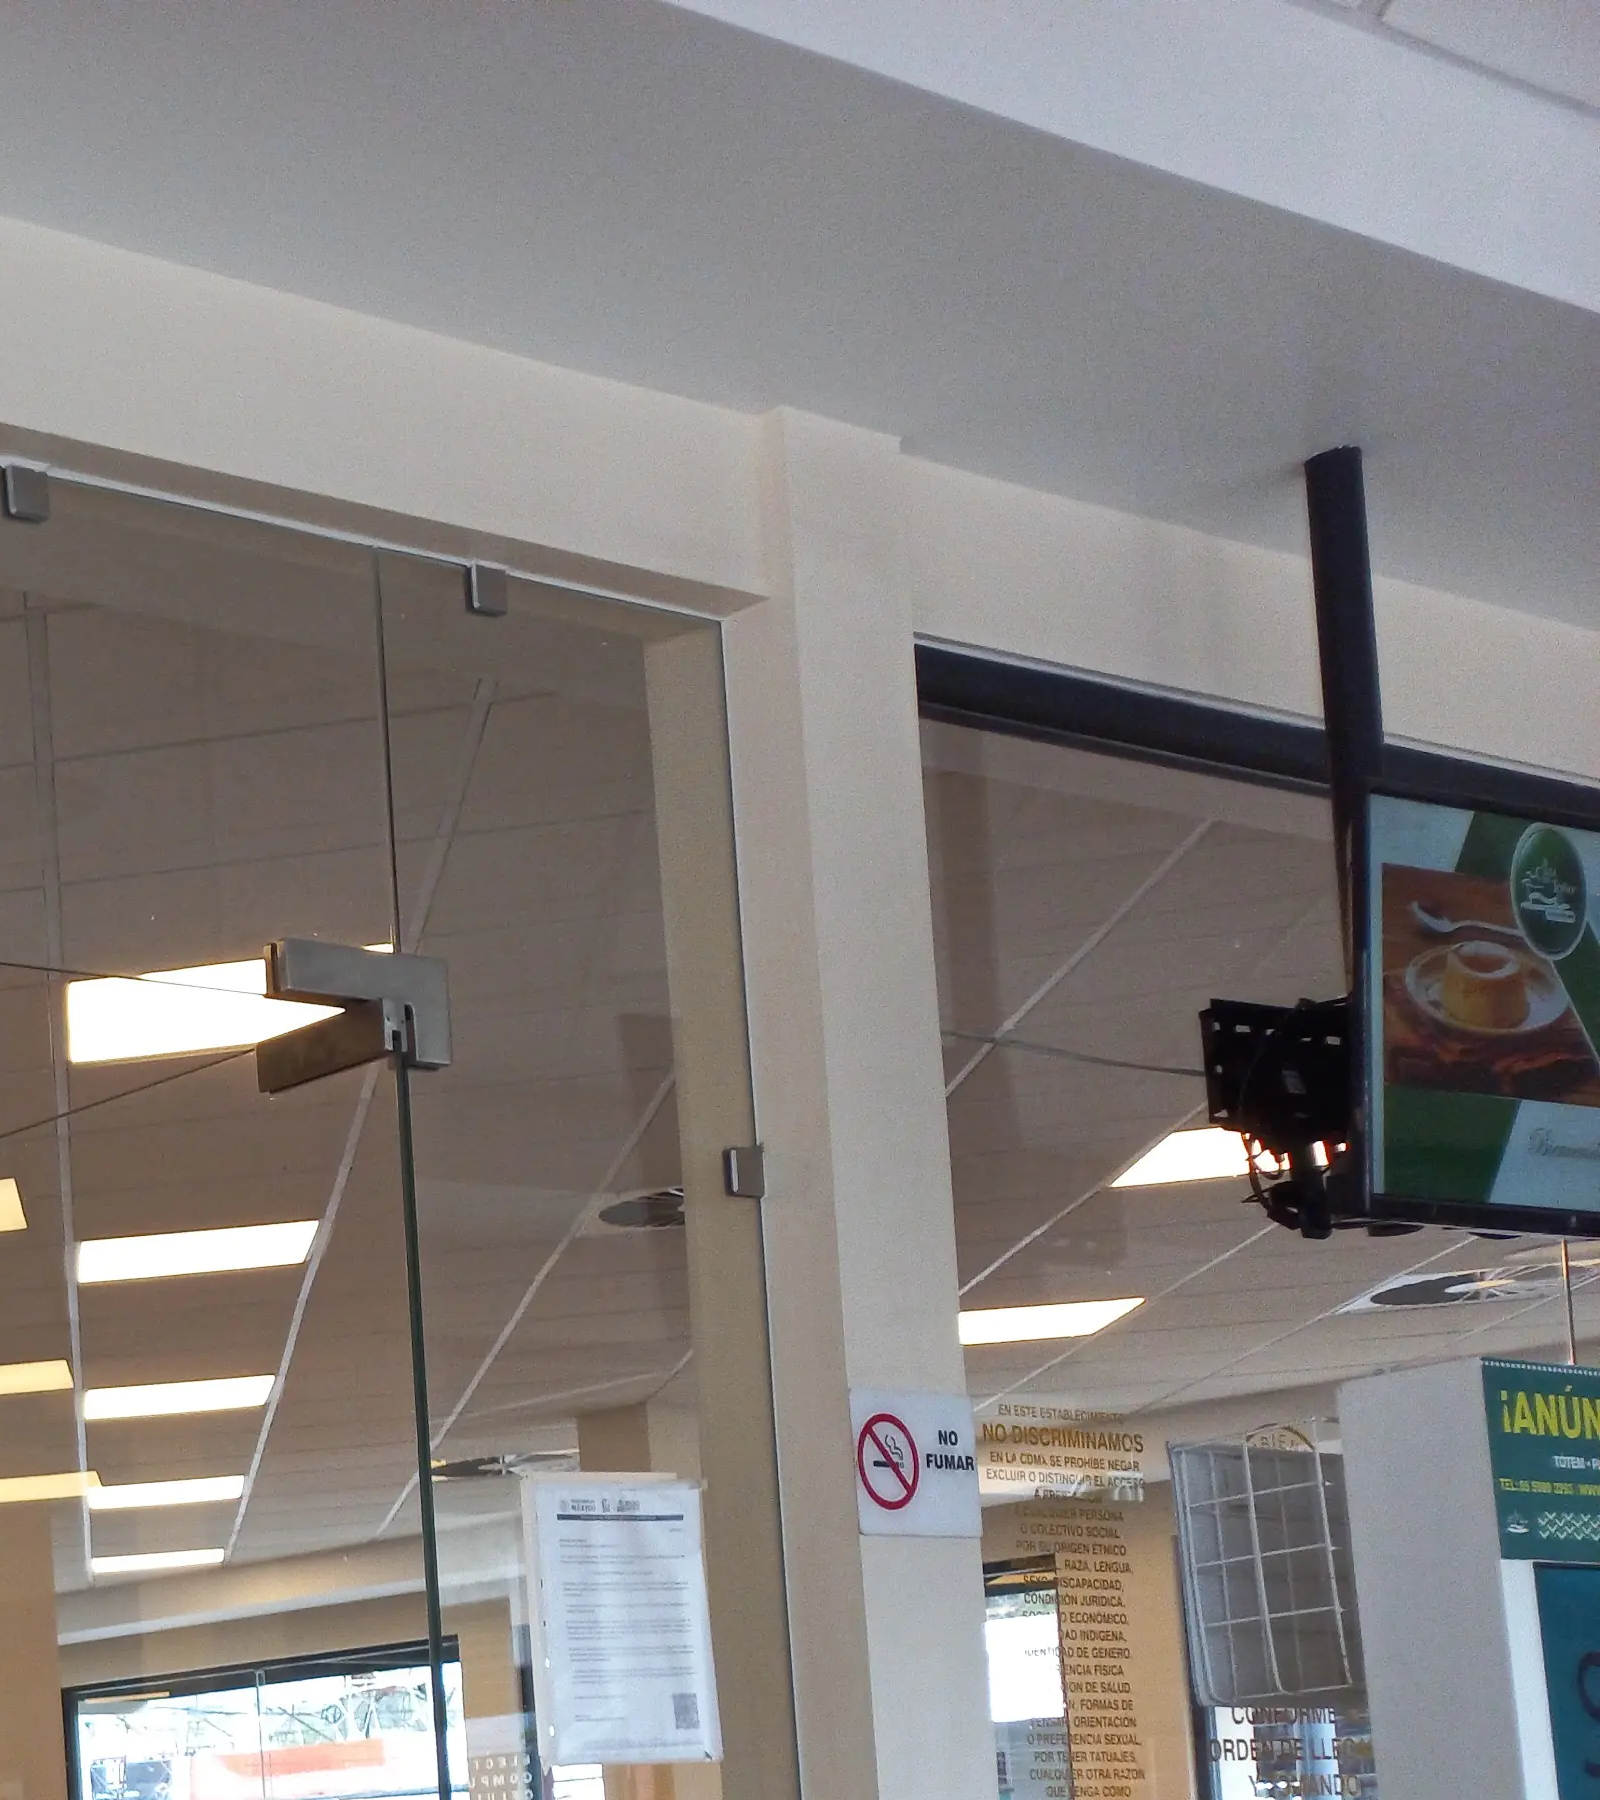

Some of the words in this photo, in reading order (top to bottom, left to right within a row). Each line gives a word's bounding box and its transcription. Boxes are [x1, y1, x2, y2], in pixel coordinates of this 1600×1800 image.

[998, 1404, 1011, 1416] EN
[1013, 1406, 1037, 1418] ESTE
[937, 1428, 959, 1448] NO
[982, 1423, 1007, 1442] NO
[1011, 1424, 1144, 1453] DISCRIMINAMOS
[925, 1451, 975, 1473] FUMAR
[990, 1451, 1003, 1463] EN
[1050, 1455, 1062, 1467] SE
[1108, 1460, 1140, 1472] NEGAR
[986, 1469, 1026, 1481] EXCLUIR
[1029, 1471, 1036, 1482] O
[1038, 1471, 1092, 1486] DISTINGUIR
[1094, 1476, 1105, 1487] EL
[1031, 1524, 1083, 1537] COLECTIVO
[1086, 1526, 1120, 1539] SOCIAL
[1016, 1540, 1036, 1551] POR
[1054, 1542, 1090, 1555] ORIGEN
[1077, 1648, 1089, 1658] DE
[1086, 1682, 1098, 1693] DE
[1080, 1699, 1119, 1711] FORMAS
[1122, 1699, 1133, 1711] DE
[1037, 1734, 1102, 1747] PREFERENCIA
[1033, 1751, 1055, 1763] POR
[1209, 1738, 1274, 1762] ORDEN
[1086, 1769, 1111, 1780] OTRA
[1046, 1786, 1066, 1798] QUE
[1074, 1786, 1100, 1798] ENGA
[1102, 1786, 1131, 1798] COMO
